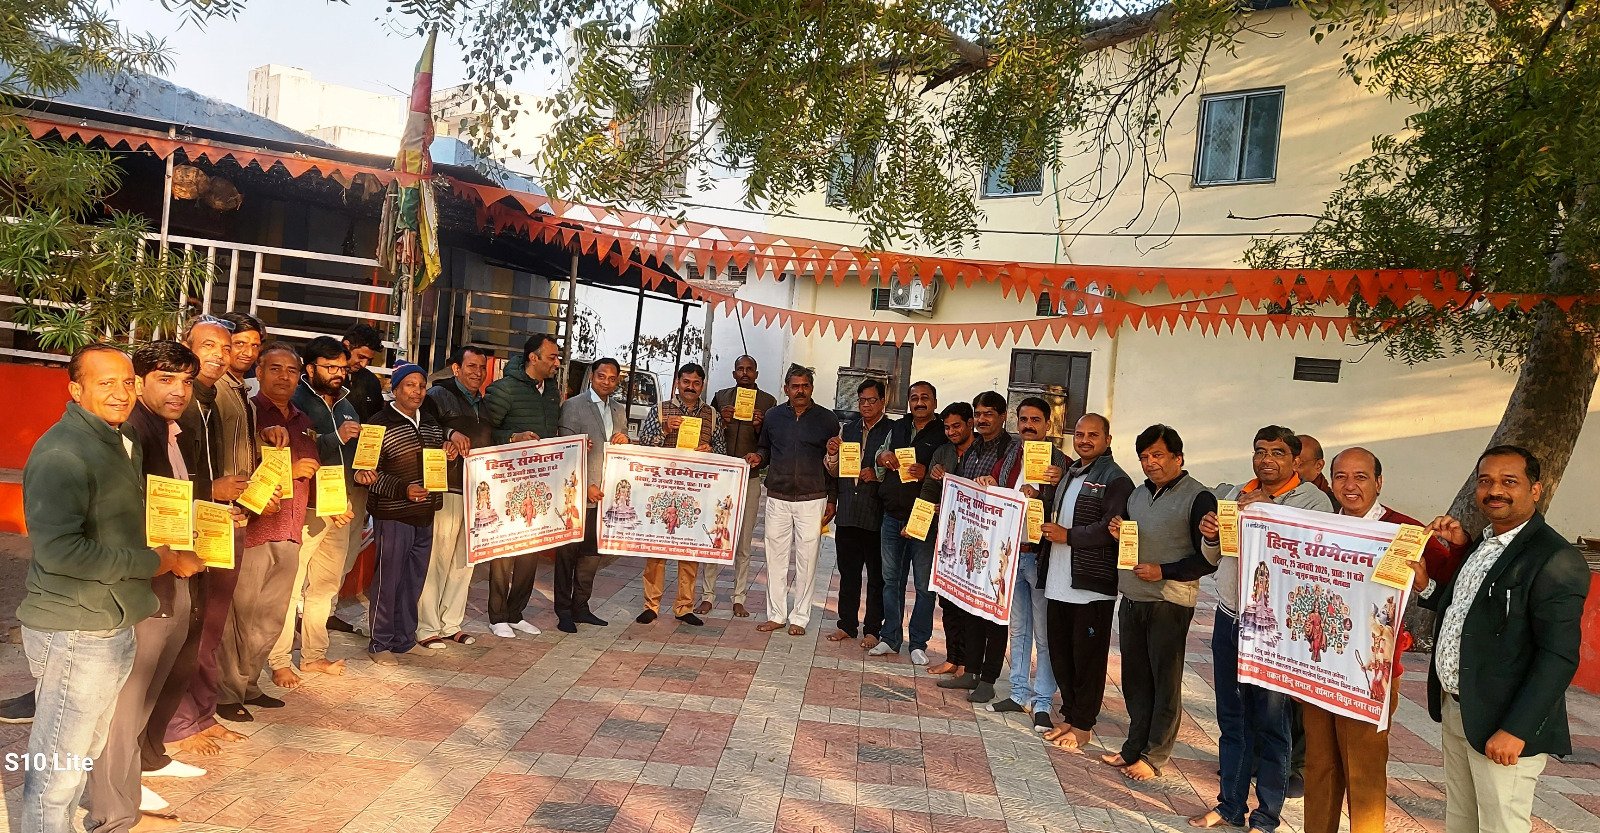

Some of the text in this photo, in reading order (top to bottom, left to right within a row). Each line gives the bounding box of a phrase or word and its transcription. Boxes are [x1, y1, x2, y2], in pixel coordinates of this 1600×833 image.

[485, 459, 515, 471] हिन्दू
[516, 451, 564, 466] सम्मेलन
[629, 462, 720, 481] हिन्दू सम्मेलन
[956, 490, 972, 510] हिन्दू
[973, 498, 1004, 517] सम्मेलन
[1266, 531, 1302, 559] हिन्दू
[1304, 542, 1377, 568] सम्मेलन
[1272, 555, 1289, 568] रविवार,
[1290, 560, 1296, 568] 25
[1296, 561, 1314, 573] जनवरी
[1331, 569, 1345, 578] प्रातः
[1347, 571, 1352, 580] 11
[1353, 572, 1364, 582] बजे
[1282, 673, 1295, 688] हिन्दू
